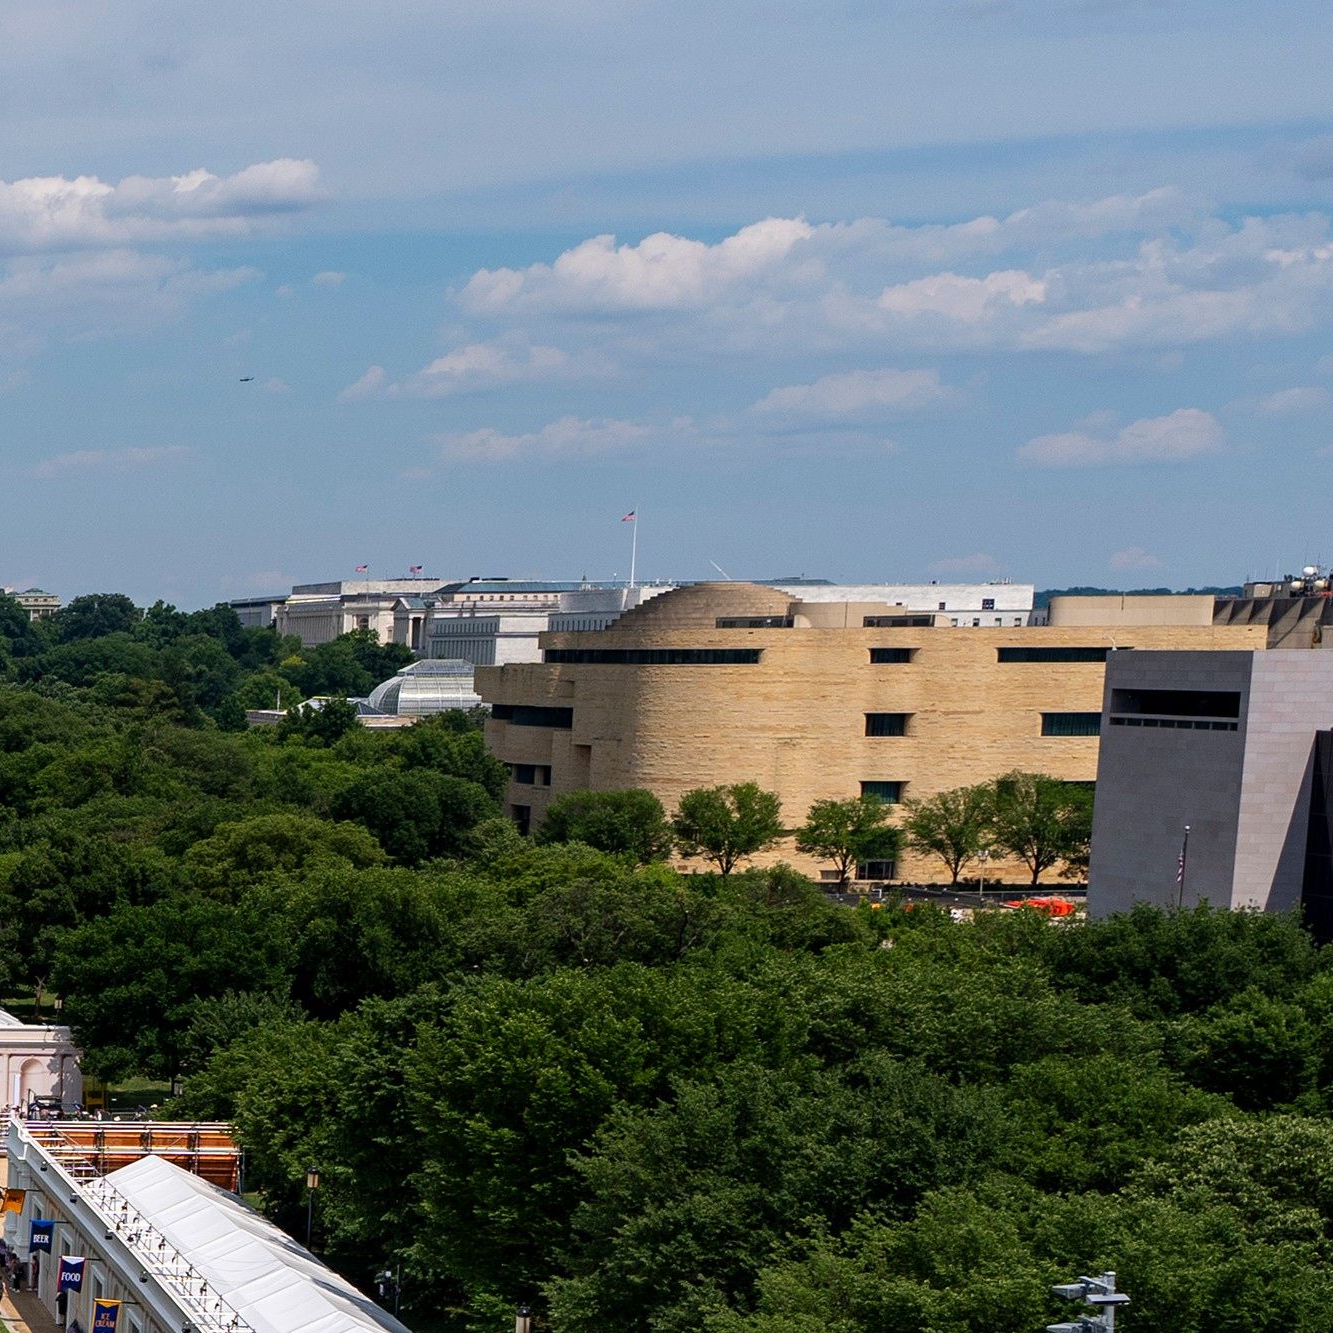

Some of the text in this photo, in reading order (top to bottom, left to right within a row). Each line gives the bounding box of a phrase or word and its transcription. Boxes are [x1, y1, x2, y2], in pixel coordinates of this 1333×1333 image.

[33, 1234, 49, 1243] BEER
[61, 1272, 81, 1282] FOOD
[101, 1313, 110, 1321] ICE
[95, 1320, 115, 1328] CREAM
